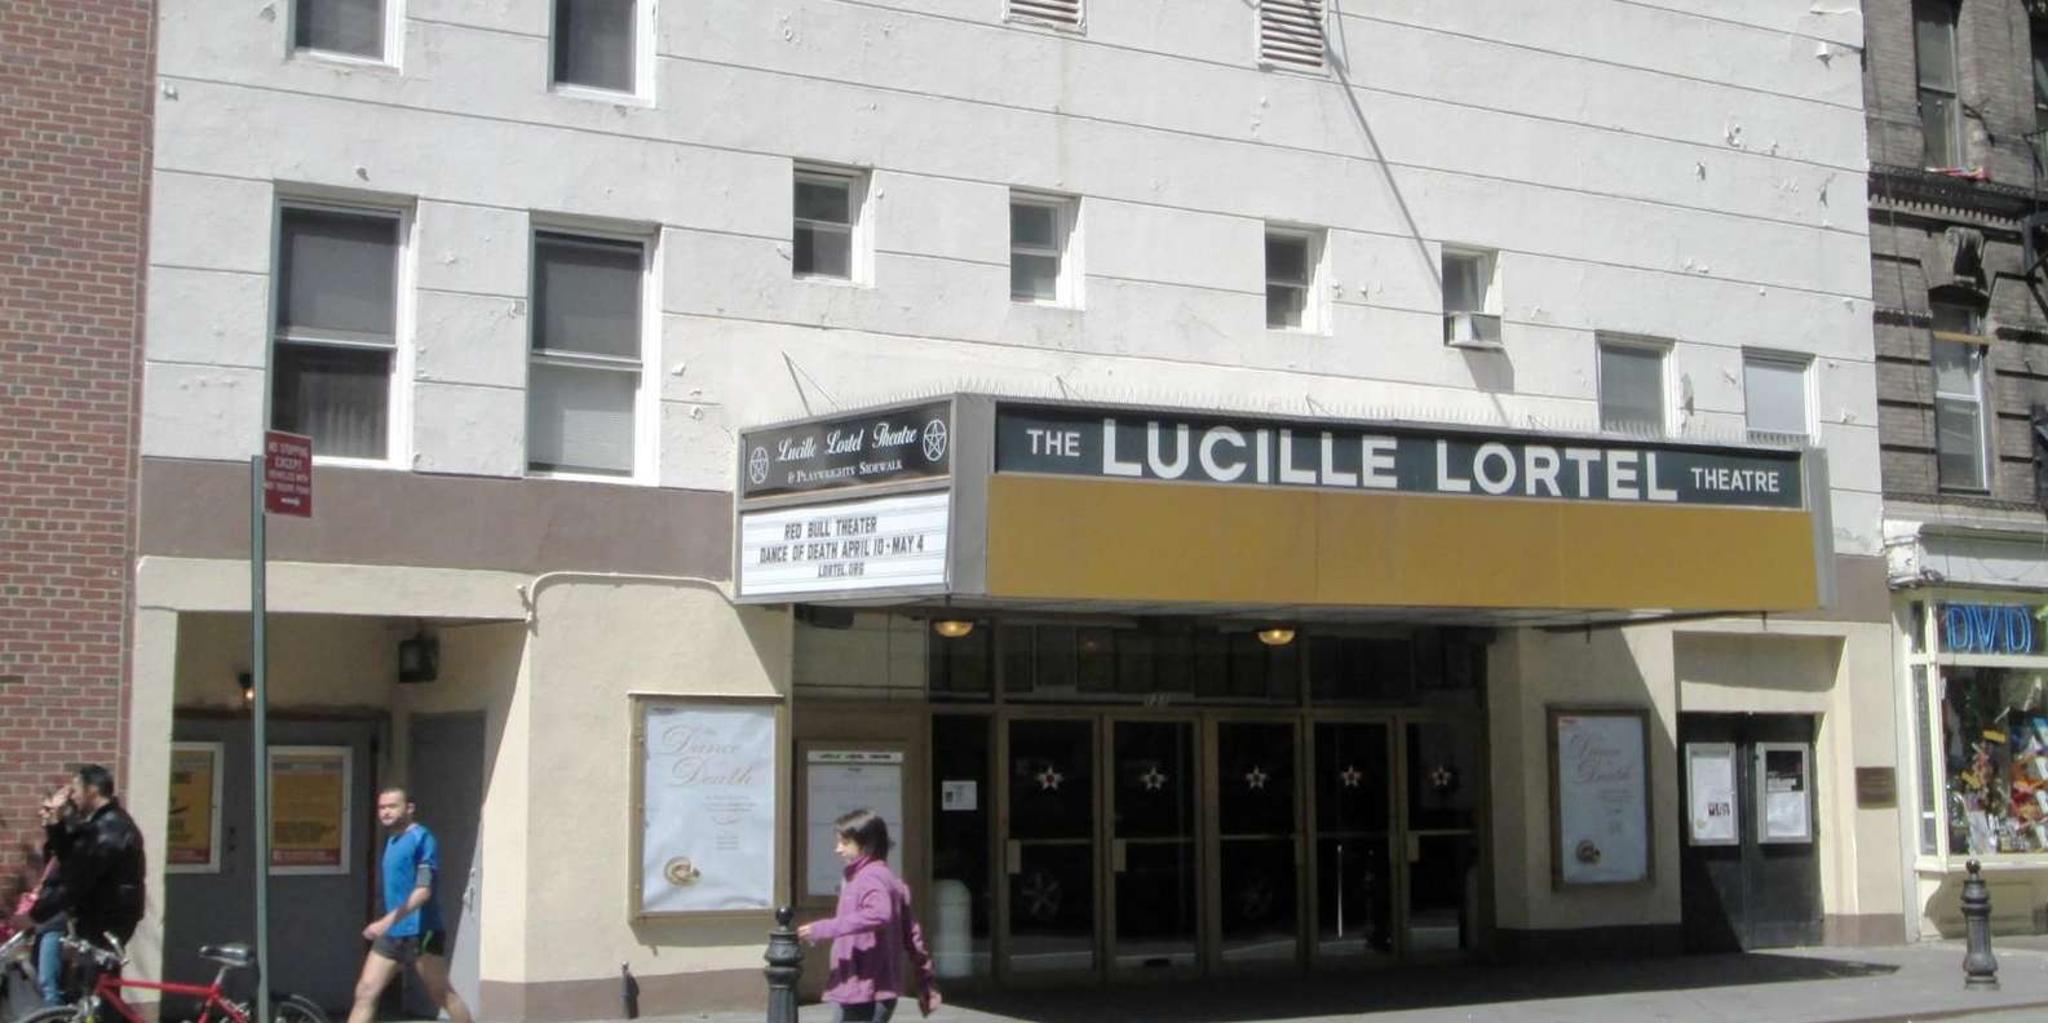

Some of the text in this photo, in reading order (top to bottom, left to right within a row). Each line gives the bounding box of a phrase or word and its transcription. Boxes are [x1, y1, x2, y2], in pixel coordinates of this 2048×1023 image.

[777, 421, 917, 462] Lucille Lortel Theatre
[1026, 418, 1780, 501] THE LUCILLE LORTEL THEATRE
[784, 516, 877, 540] RED BULL THEATER
[760, 545, 787, 564] DANCE
[792, 545, 804, 561] OF
[807, 542, 838, 560] DEATH
[842, 539, 870, 557] APRIL
[916, 535, 924, 552] 4
[1945, 605, 2032, 654] DVD
